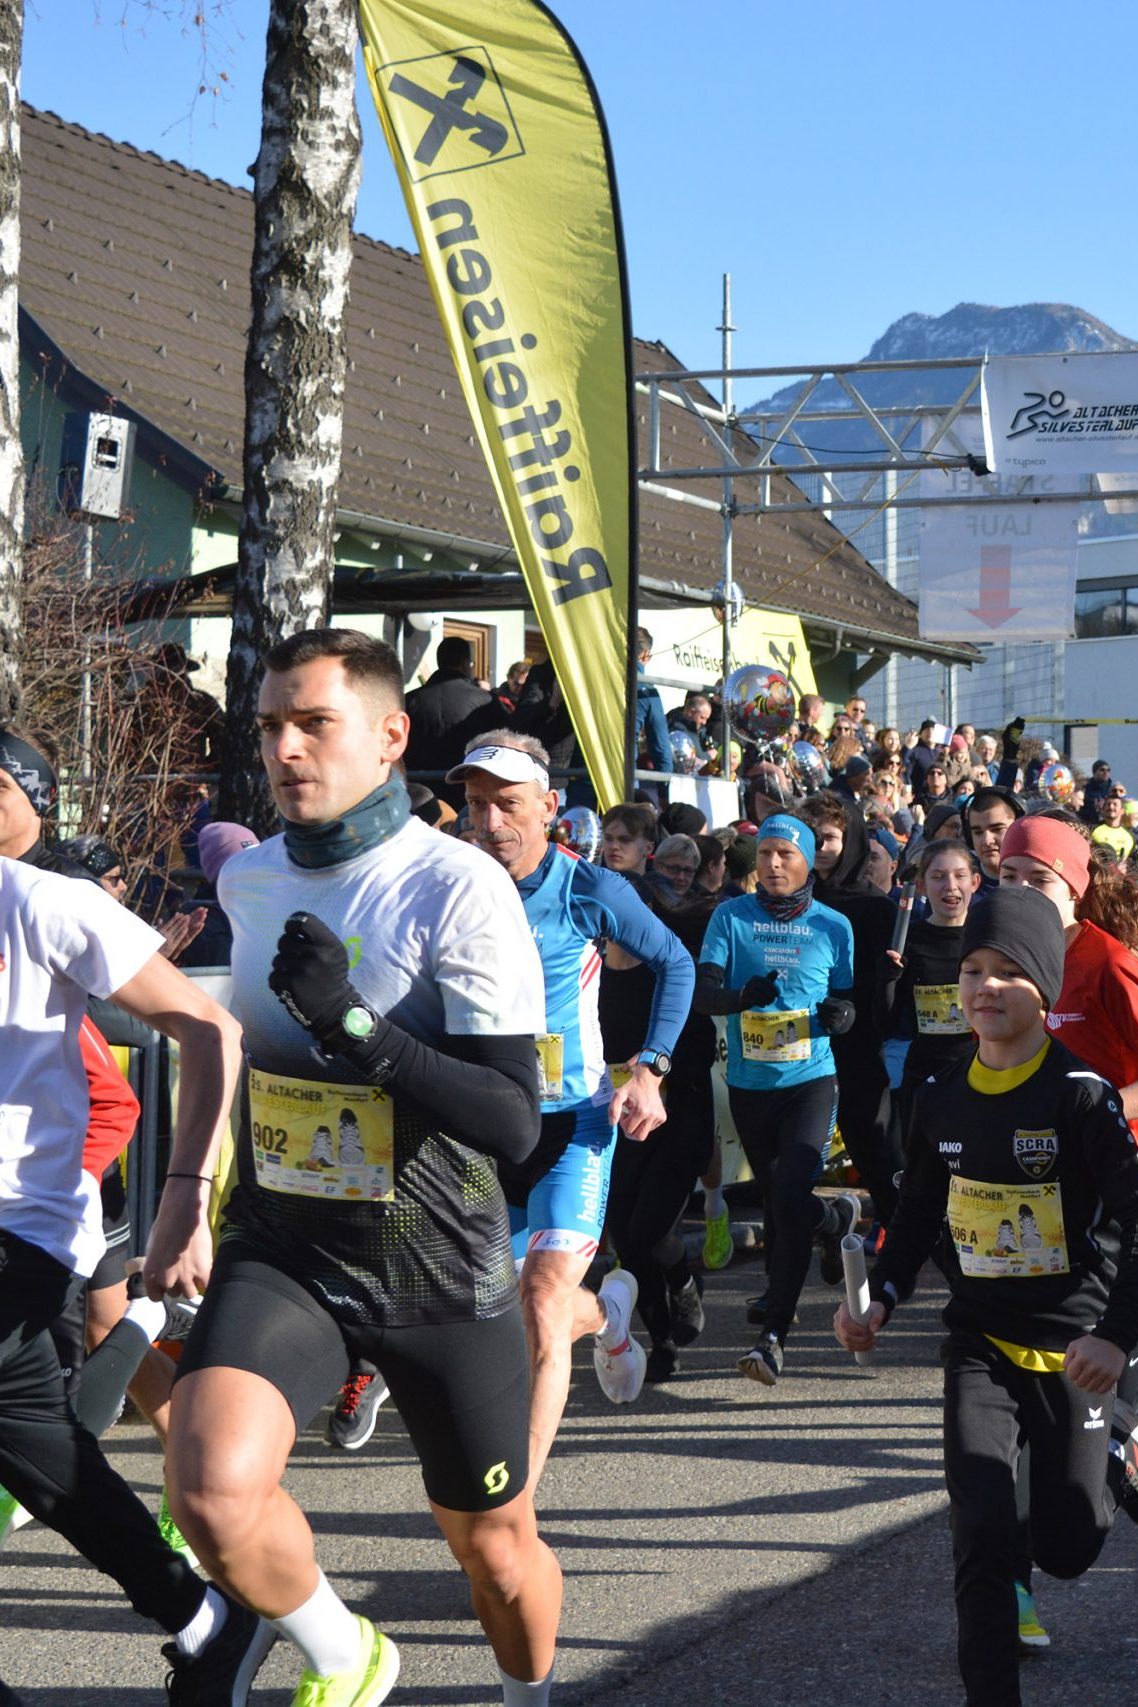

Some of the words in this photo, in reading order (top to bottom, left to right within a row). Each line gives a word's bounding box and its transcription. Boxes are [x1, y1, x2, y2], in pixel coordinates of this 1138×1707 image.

[743, 1031, 764, 1045] 840
[266, 1083, 324, 1103] ALTACHER
[253, 1121, 288, 1155] 902
[1016, 1138, 1055, 1151] SCRA
[961, 1186, 1004, 1201] ALTACHER
[970, 1230, 979, 1244] A
